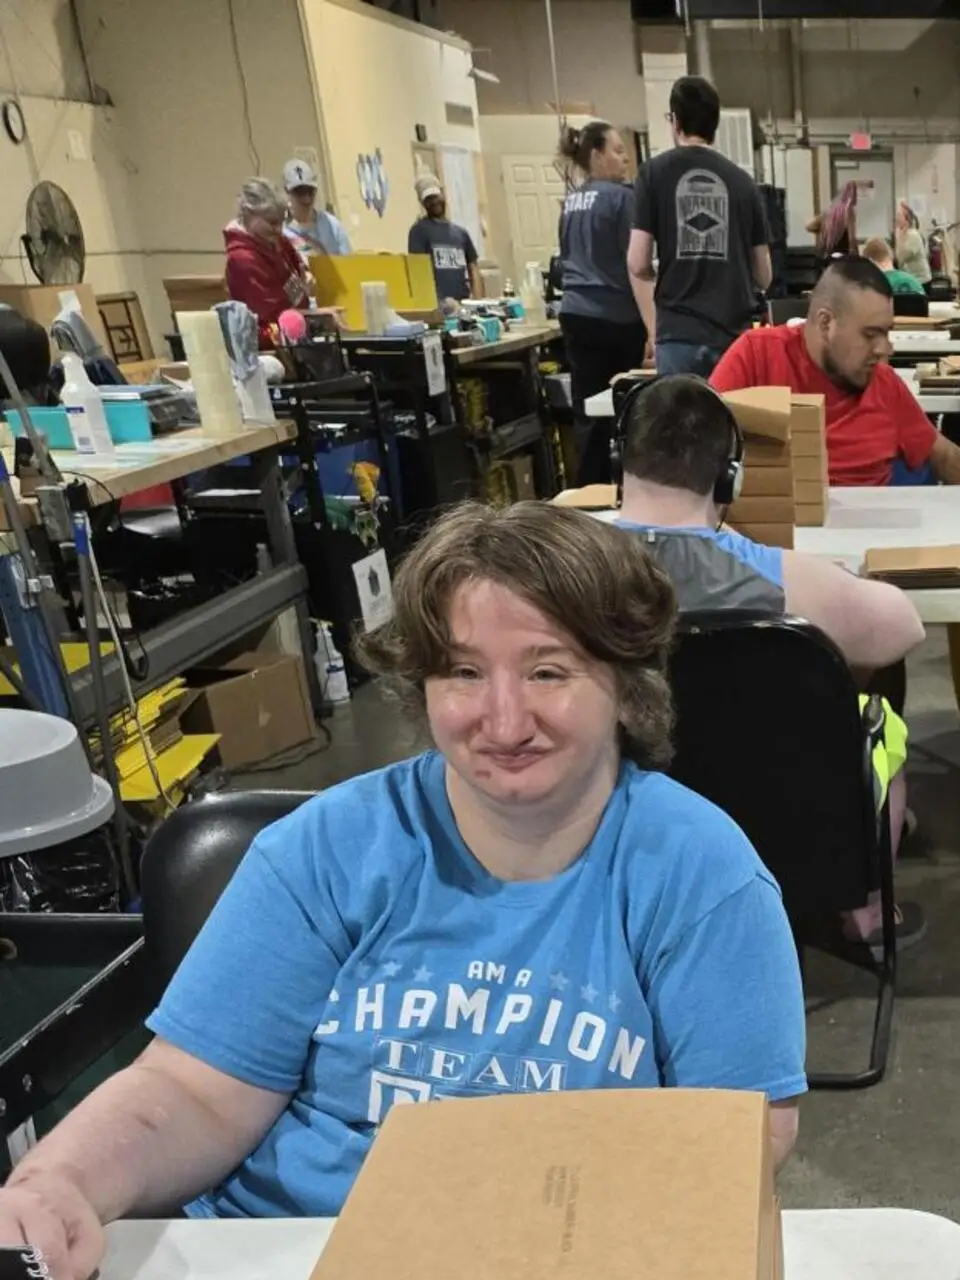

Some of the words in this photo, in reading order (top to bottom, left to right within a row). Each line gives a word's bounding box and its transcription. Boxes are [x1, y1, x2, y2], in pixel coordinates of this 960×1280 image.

[467, 960, 506, 984] AM
[514, 968, 533, 988] A
[376, 1036, 566, 1092] TEAM
